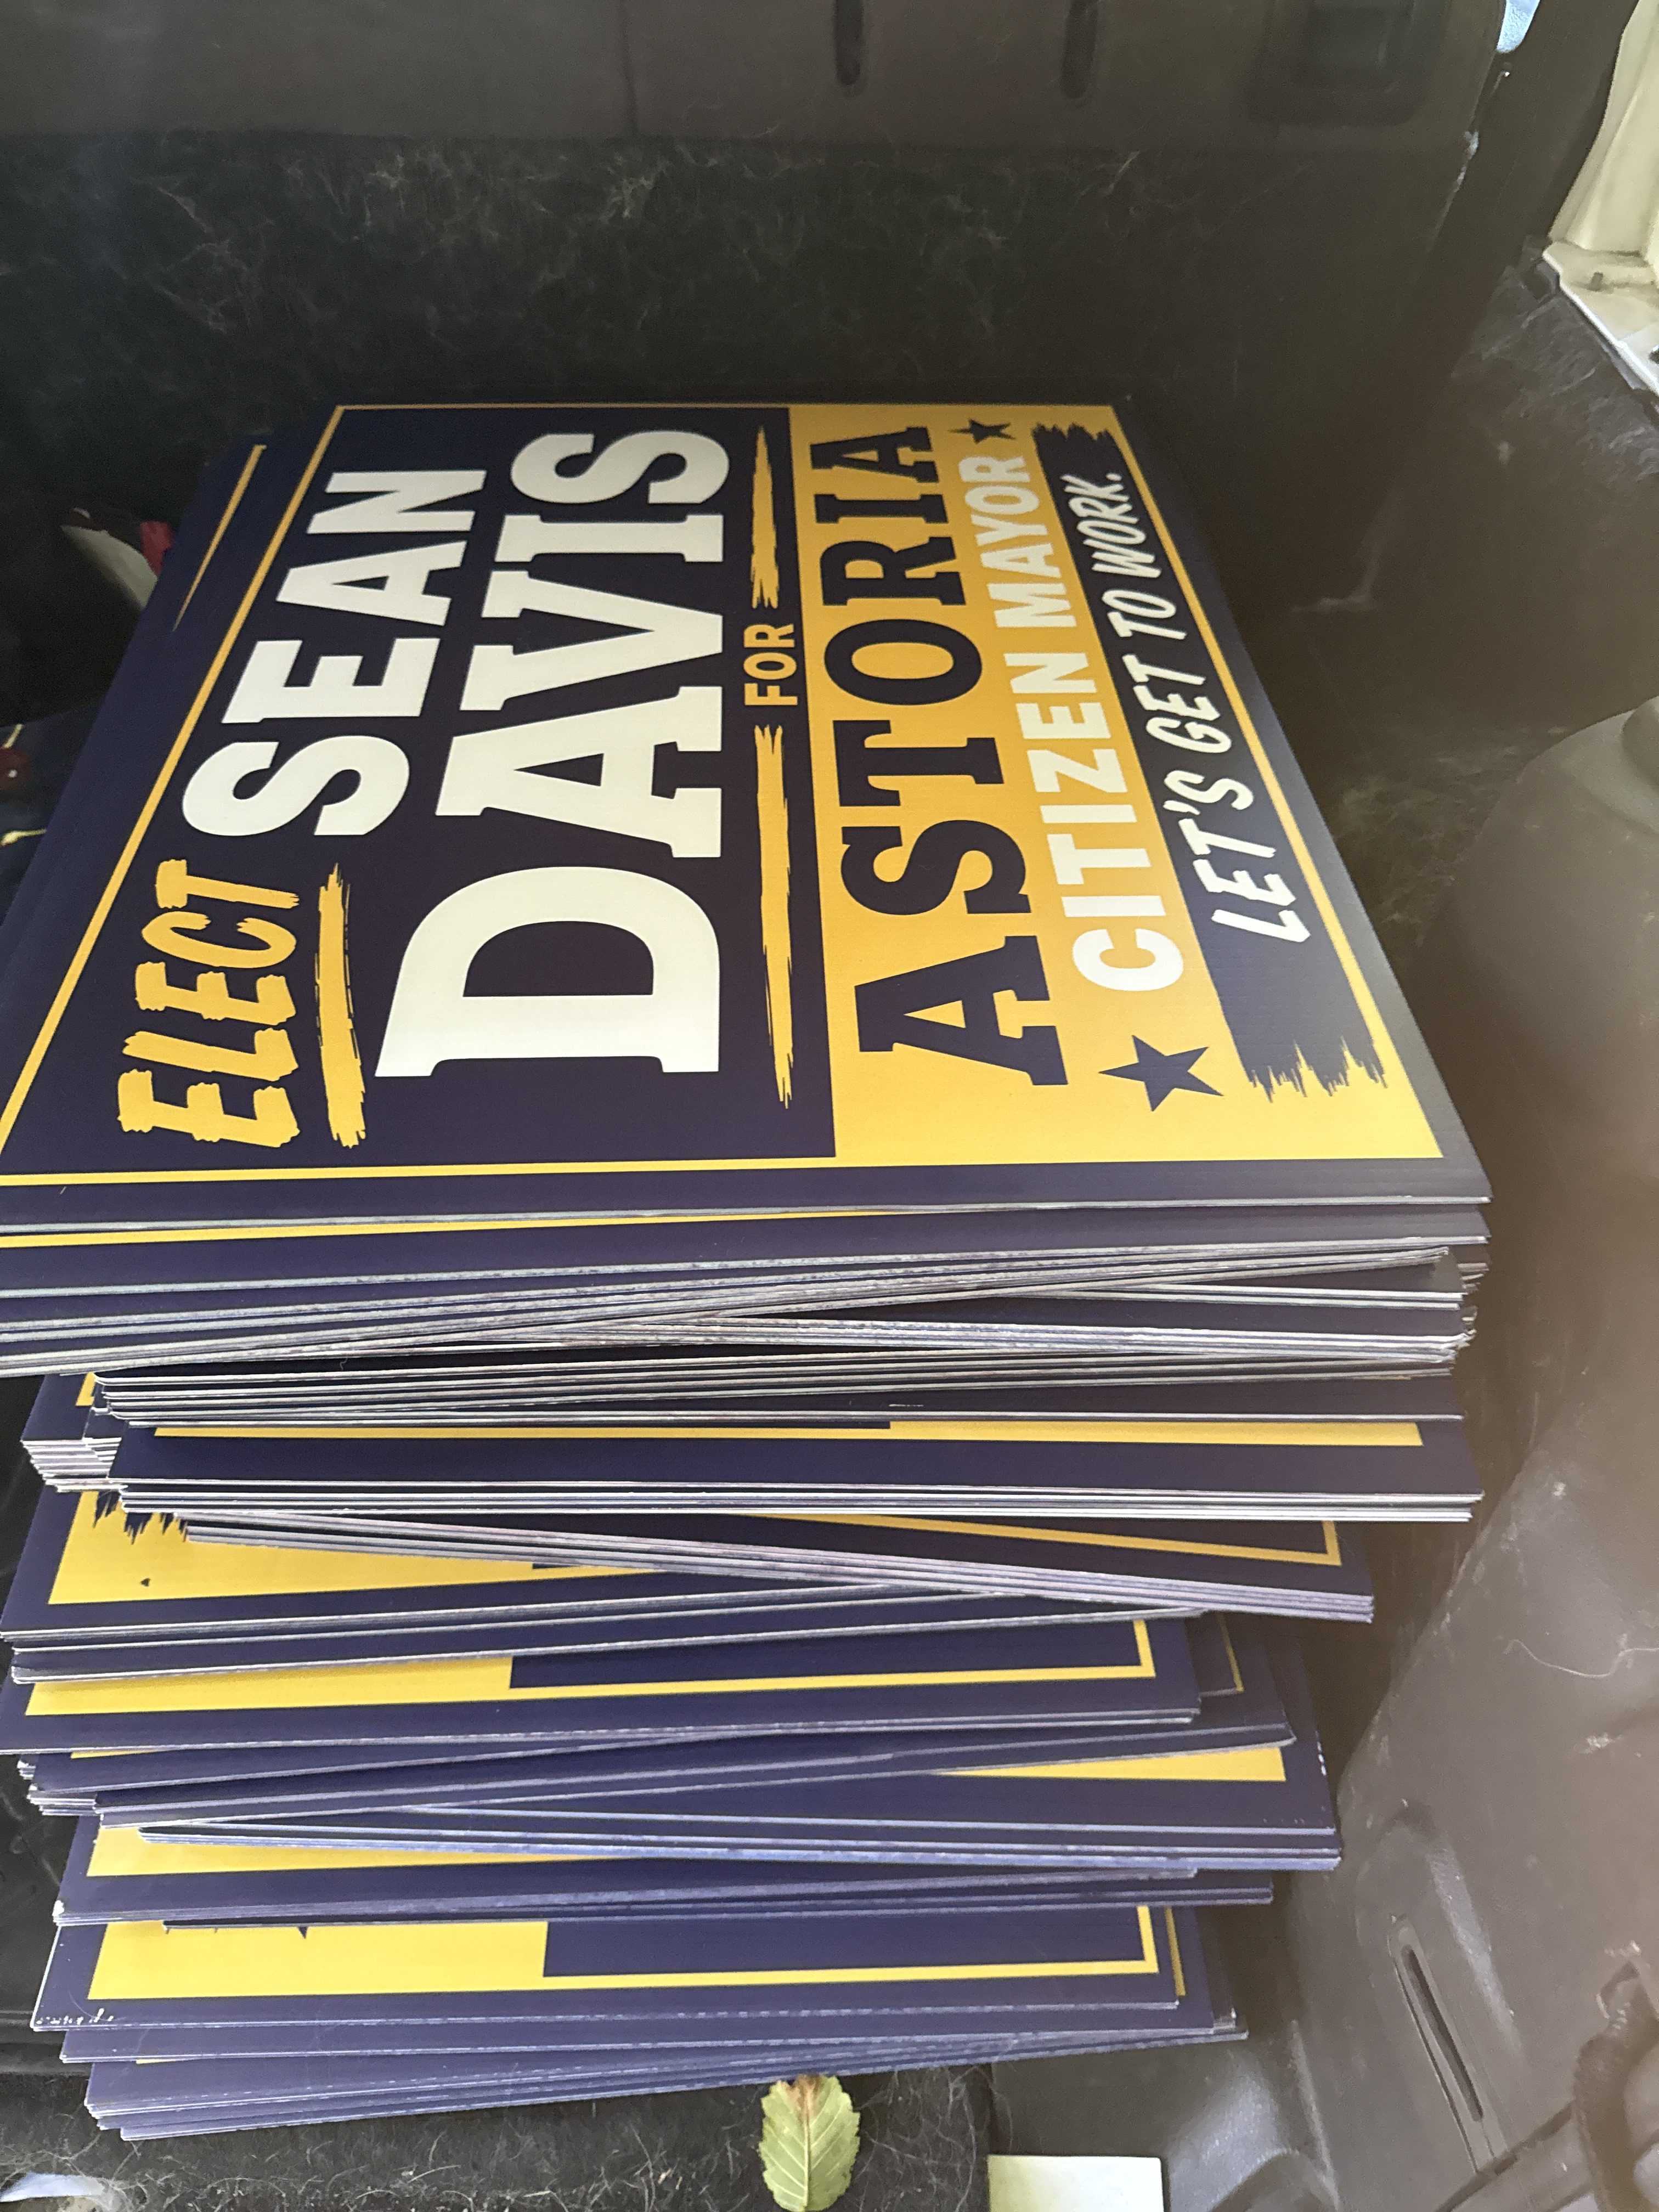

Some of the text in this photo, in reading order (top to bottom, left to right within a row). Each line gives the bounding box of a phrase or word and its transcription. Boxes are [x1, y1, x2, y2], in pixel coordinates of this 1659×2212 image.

[183, 470, 487, 836] SEAN
[375, 430, 730, 1077] DAVIS
[744, 624, 798, 706] FOR
[810, 426, 1068, 1086] ASTORIA
[958, 455, 1184, 991] CITIZEN MAYOR
[1060, 472, 1311, 942] LET'S GET TO WORK.
[117, 859, 300, 1147] ELECT
